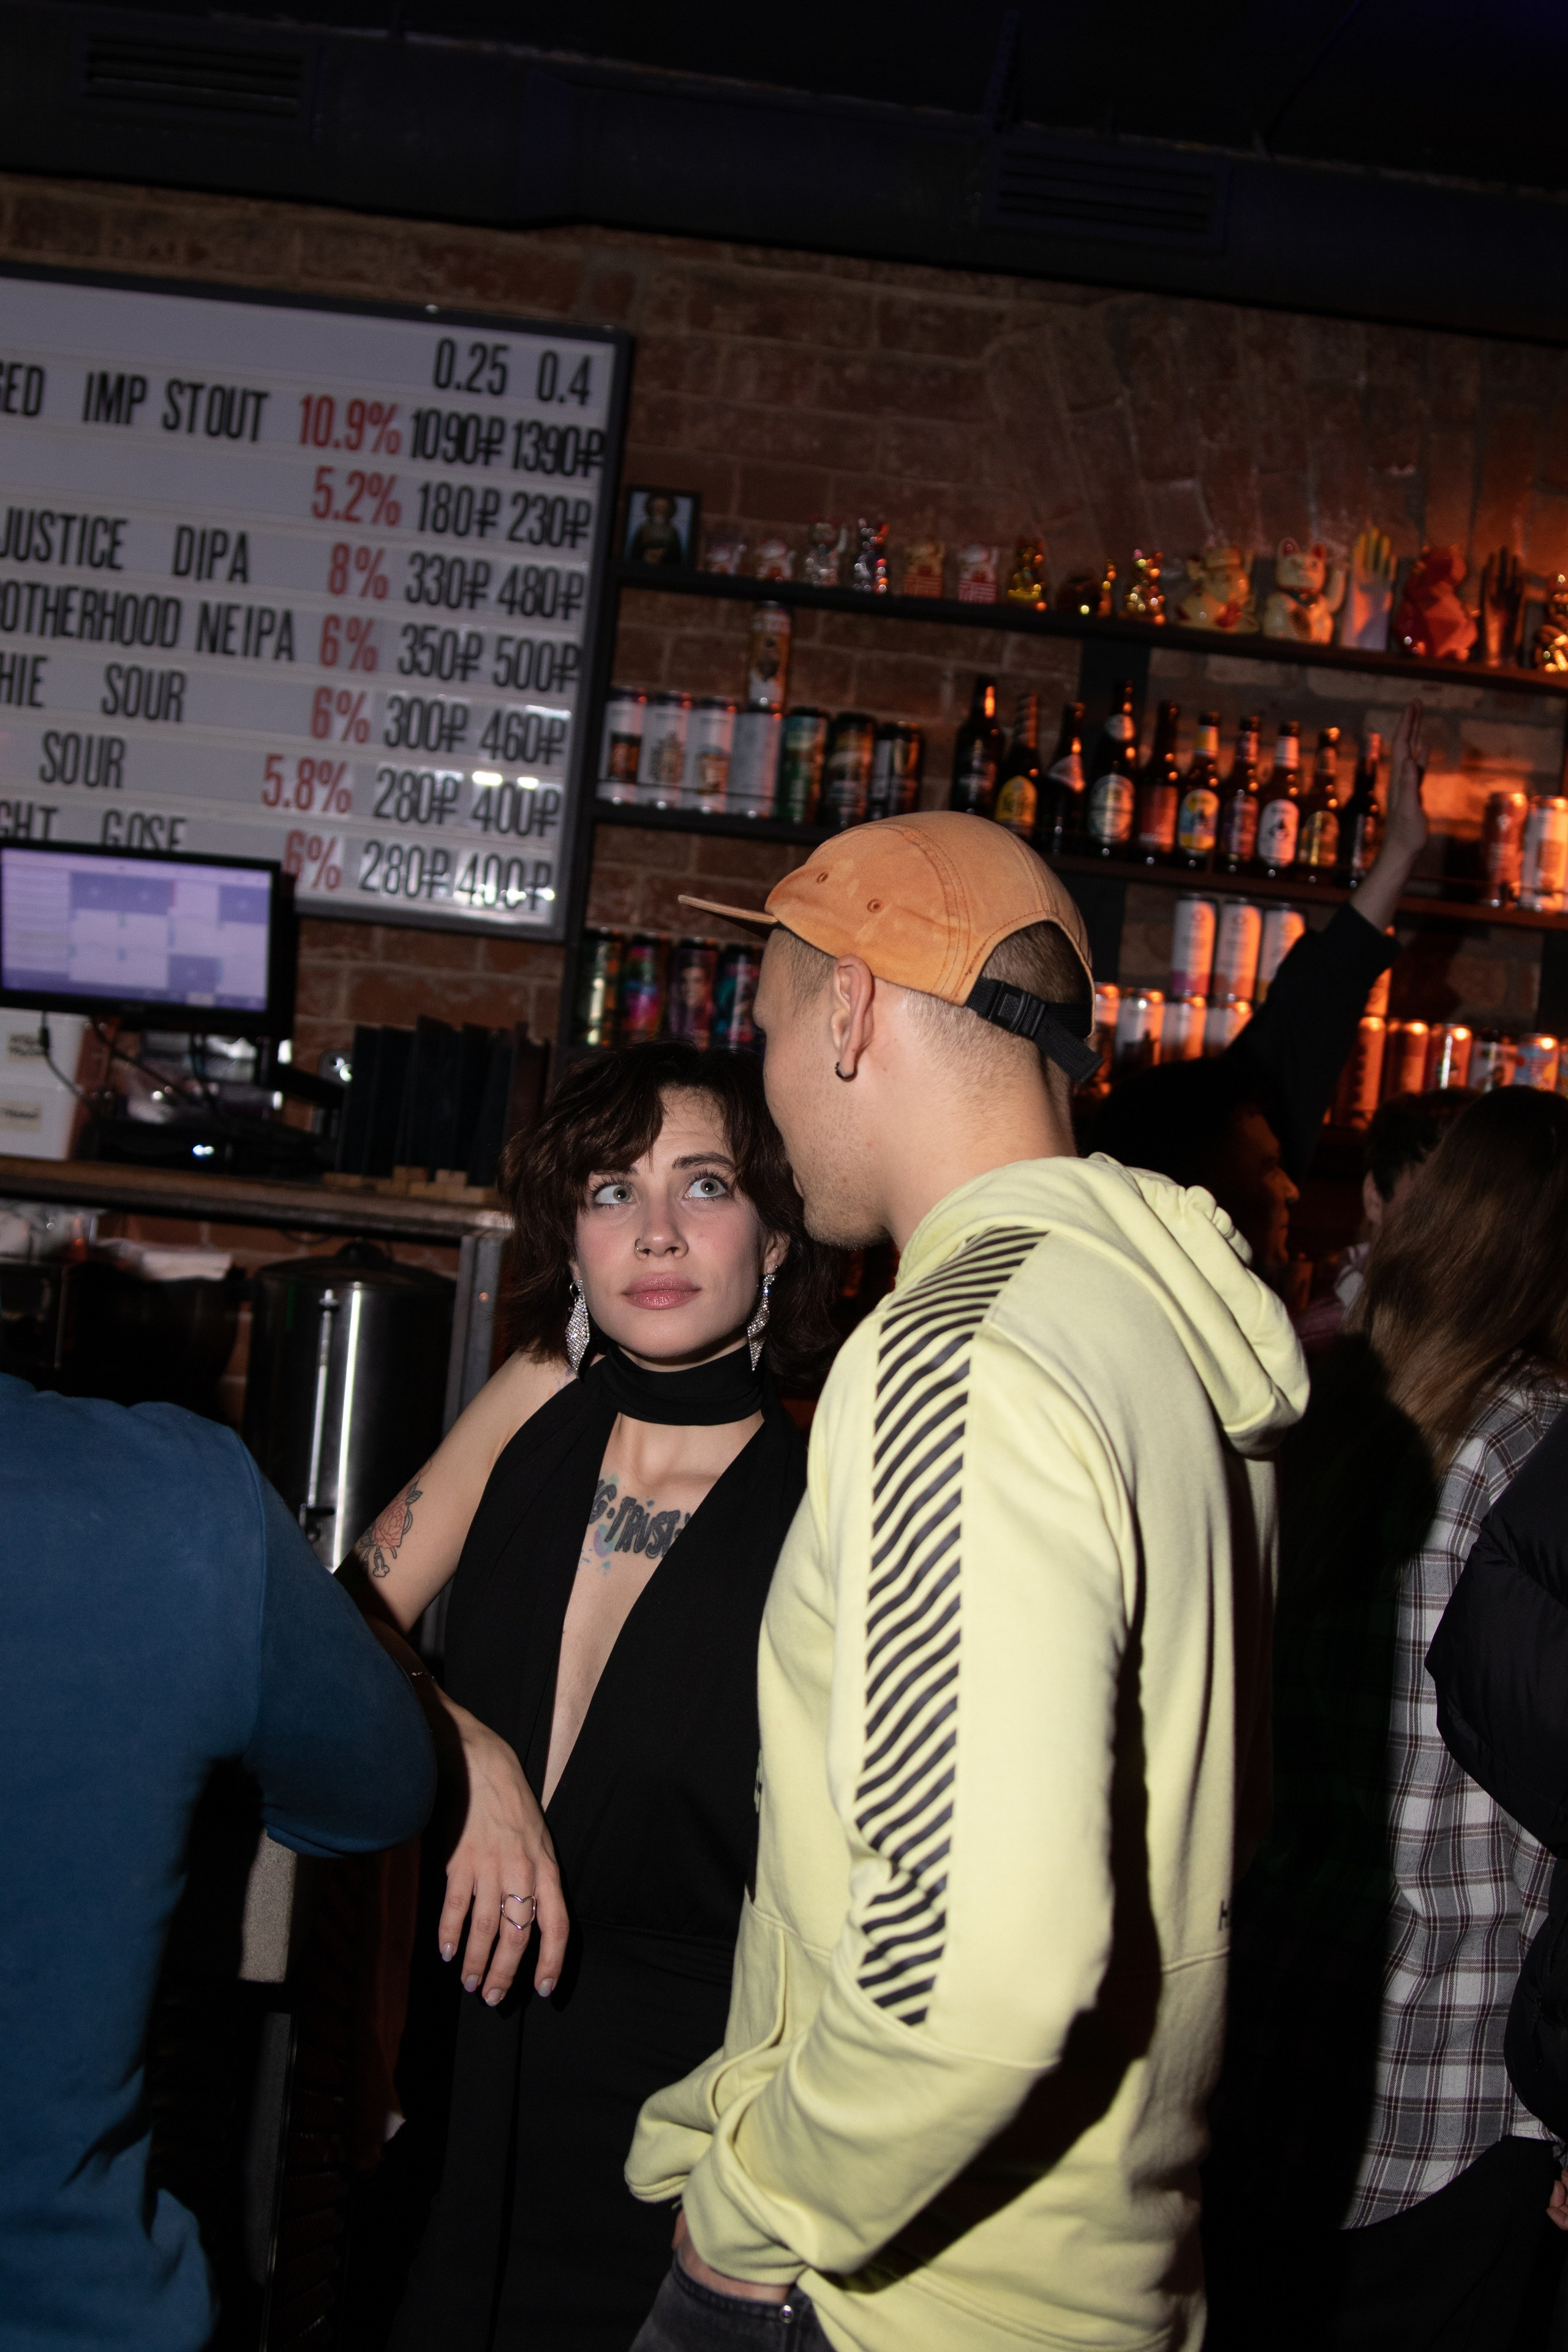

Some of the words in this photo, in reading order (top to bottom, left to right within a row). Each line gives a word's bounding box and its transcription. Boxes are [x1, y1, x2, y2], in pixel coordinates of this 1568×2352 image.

[434, 337, 510, 395] 0.25
[537, 350, 592, 406] 0.4
[82, 371, 148, 424] IMP
[162, 379, 270, 443] STOUT
[299, 394, 402, 456] 10.9%
[311, 465, 402, 527] 5.2%
[0, 506, 127, 571] JUSTICE
[172, 524, 249, 585] DIPA
[328, 543, 389, 601] 8%
[0, 579, 183, 649] OTHERHOOD
[195, 600, 296, 663] NEIPA
[320, 614, 380, 673] 6%
[101, 663, 186, 723] SOUR
[311, 685, 371, 745] 6%
[39, 729, 126, 790] SOUR
[262, 753, 352, 815] 5.8%
[282, 830, 341, 891] 6%
